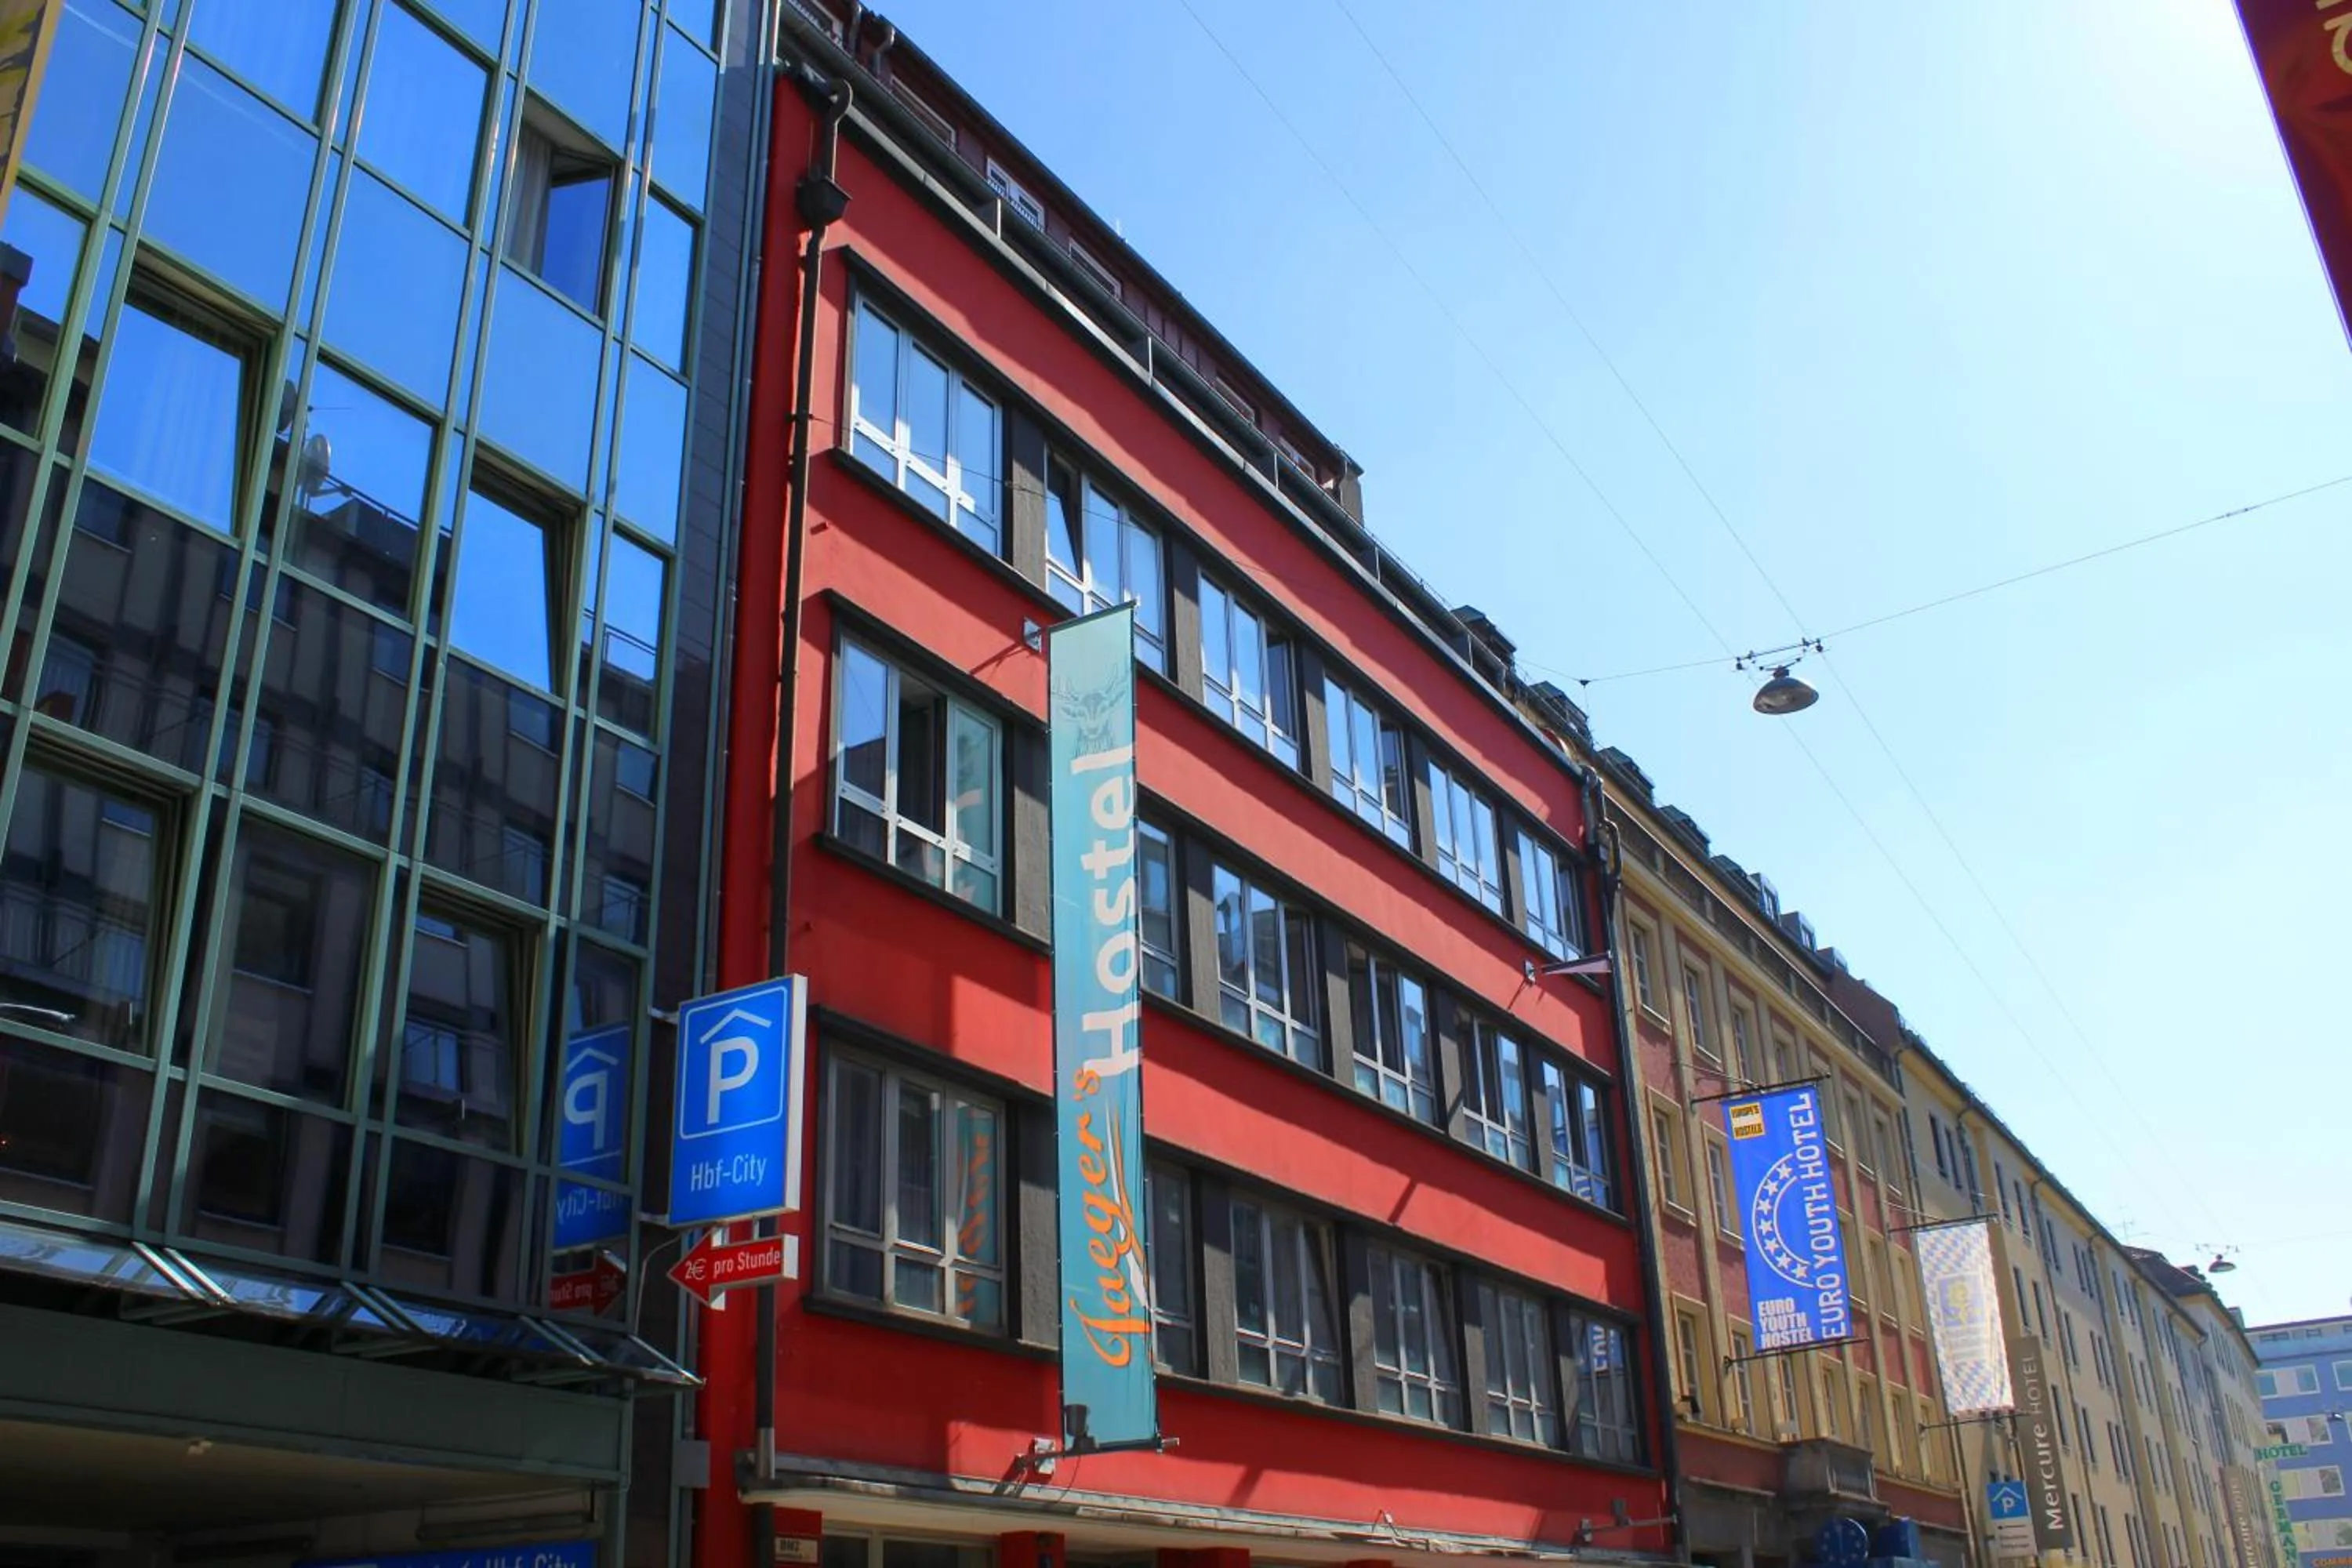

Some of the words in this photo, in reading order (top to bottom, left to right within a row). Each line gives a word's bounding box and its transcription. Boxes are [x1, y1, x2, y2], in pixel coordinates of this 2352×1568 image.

[1069, 743, 1142, 1078] Hostel
[706, 1036, 759, 1125] P
[1788, 1093, 1824, 1179] HOTEL
[691, 1153, 768, 1192] Hbf-City
[1802, 1181, 1839, 1269] YOUTH
[684, 1257, 706, 1280] 2€
[713, 1258, 735, 1279] pro
[737, 1246, 781, 1271] Stunde
[1757, 1296, 1795, 1317] EURO
[1759, 1311, 1807, 1334] YOUTH
[1816, 1272, 1846, 1339] EURO
[1760, 1327, 1814, 1349] HOSTEL
[2020, 1352, 2043, 1415] HOTEL
[2033, 1422, 2064, 1530] Mercure
[2255, 1443, 2308, 1461] HOTEL
[2002, 1497, 2015, 1514] P
